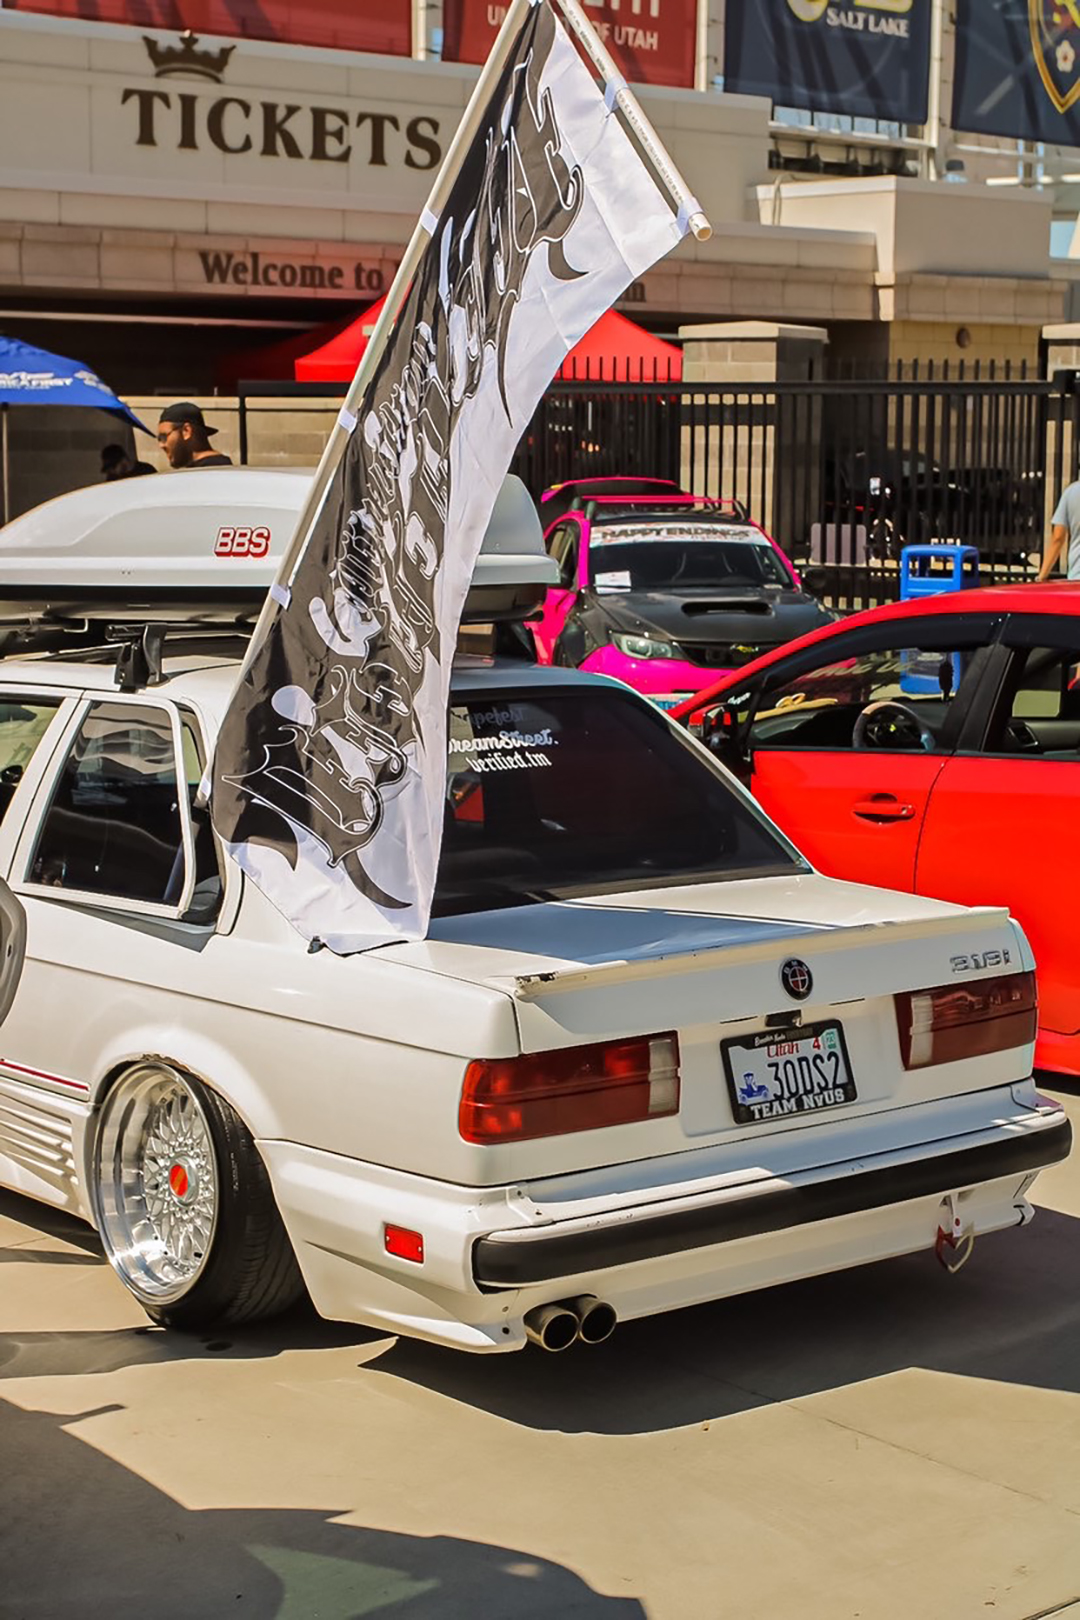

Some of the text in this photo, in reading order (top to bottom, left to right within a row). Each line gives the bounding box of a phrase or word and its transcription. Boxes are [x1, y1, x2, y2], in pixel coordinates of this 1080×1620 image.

[826, 7, 909, 38] SALT LAKE
[614, 26, 659, 51] UTAH
[121, 88, 443, 170] TICKETS
[199, 251, 384, 291] Welcome to
[214, 526, 271, 558] BBS
[750, 1097, 798, 1120] TEAM
